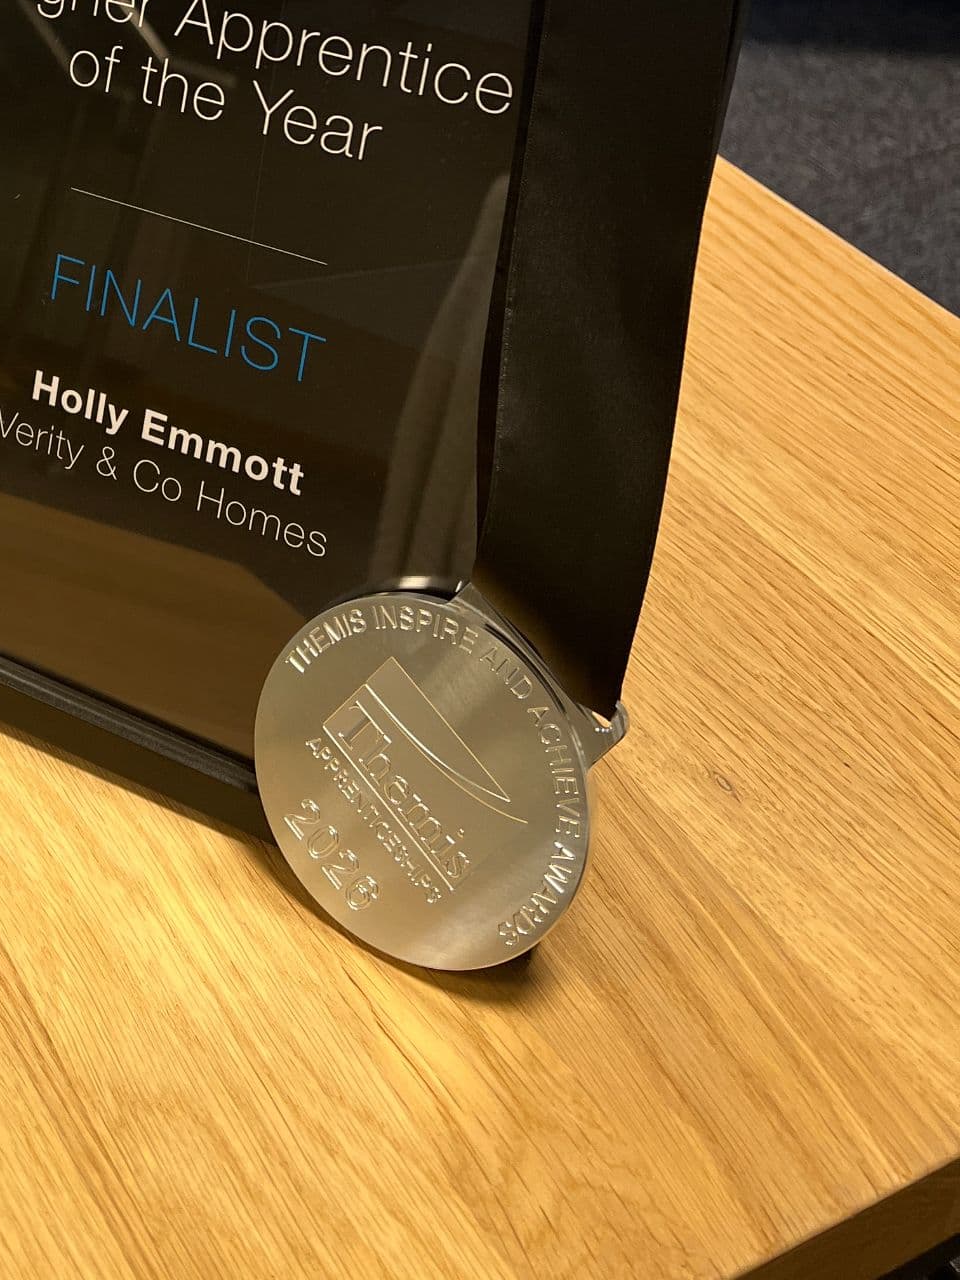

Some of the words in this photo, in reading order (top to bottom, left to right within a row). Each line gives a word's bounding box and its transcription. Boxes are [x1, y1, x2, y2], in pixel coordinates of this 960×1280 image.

[69, 45, 124, 93] of
[141, 56, 226, 120] the
[253, 79, 383, 160] Year
[51, 253, 327, 382] FINALIST
[32, 370, 129, 436] Holly
[141, 408, 305, 496] Emmott
[96, 446, 118, 481] &
[133, 459, 182, 502] Co
[197, 480, 328, 557] Homes
[284, 608, 367, 674] THEMIS
[372, 605, 479, 655] INSPIRE
[479, 645, 534, 700] AND
[338, 700, 472, 880] Themis
[527, 706, 581, 838] ACHIEVE
[284, 798, 380, 911] 2026
[498, 841, 576, 946] AWARDS
